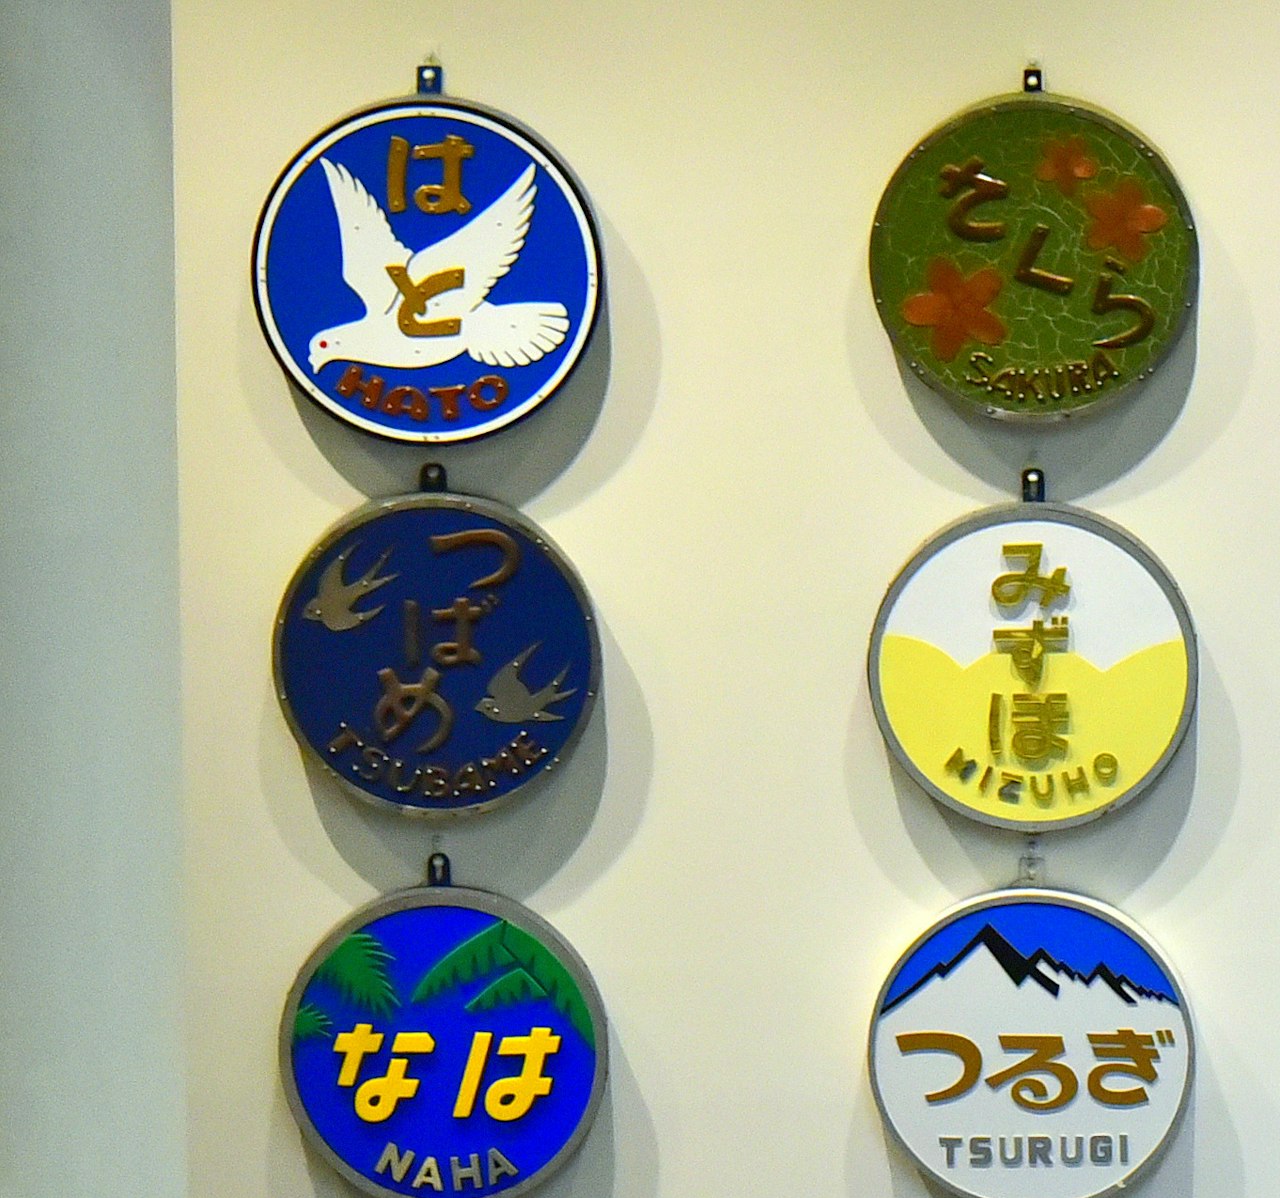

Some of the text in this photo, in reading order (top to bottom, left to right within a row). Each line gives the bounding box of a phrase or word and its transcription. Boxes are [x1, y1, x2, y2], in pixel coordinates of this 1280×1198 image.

[386, 135, 475, 338] はと
[939, 156, 1155, 349] さくら
[336, 365, 508, 421] HATO
[964, 351, 1120, 402] SAKURA
[374, 529, 522, 753] つばめ
[989, 543, 1071, 760] みずほ
[327, 722, 548, 798] TSUBAME
[945, 748, 1118, 804] MIZUHO
[333, 1023, 561, 1123] なは
[895, 1029, 1175, 1110] つるぎ
[374, 1141, 519, 1192] NAHA
[938, 1135, 1129, 1167] TSURUGI
